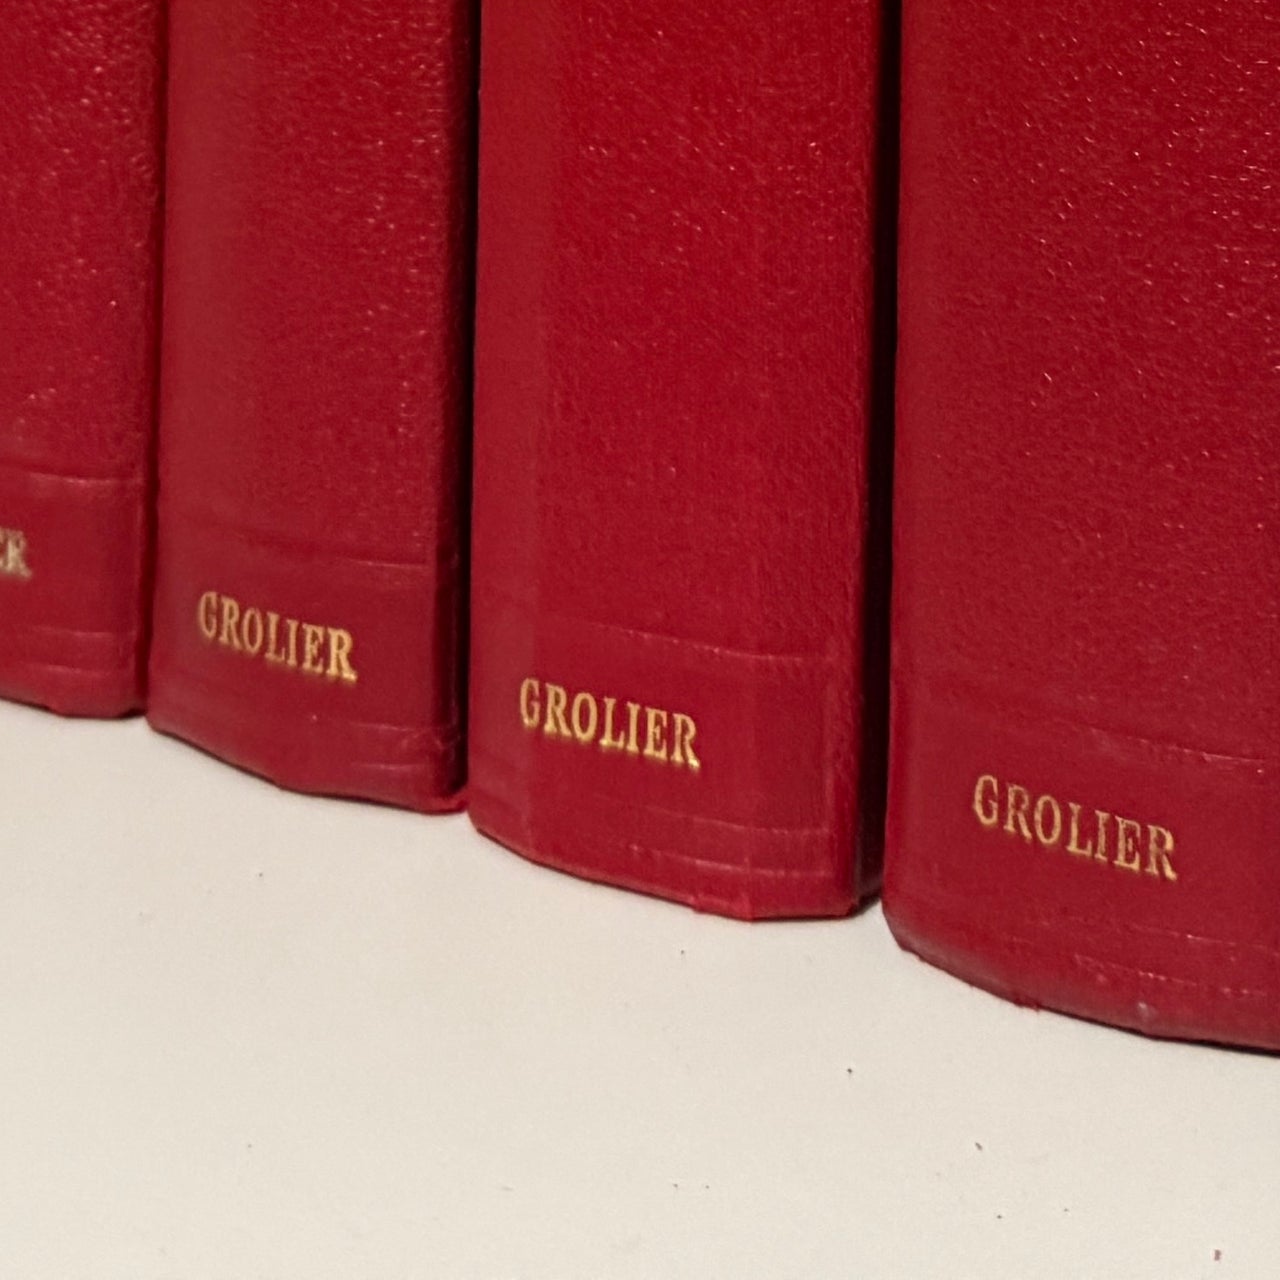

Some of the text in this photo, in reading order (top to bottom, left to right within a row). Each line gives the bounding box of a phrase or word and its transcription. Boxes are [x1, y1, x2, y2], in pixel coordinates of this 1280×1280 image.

[195, 590, 359, 687] GROLIER
[518, 676, 702, 773] GROLIER
[971, 773, 1179, 884] GROLIER
